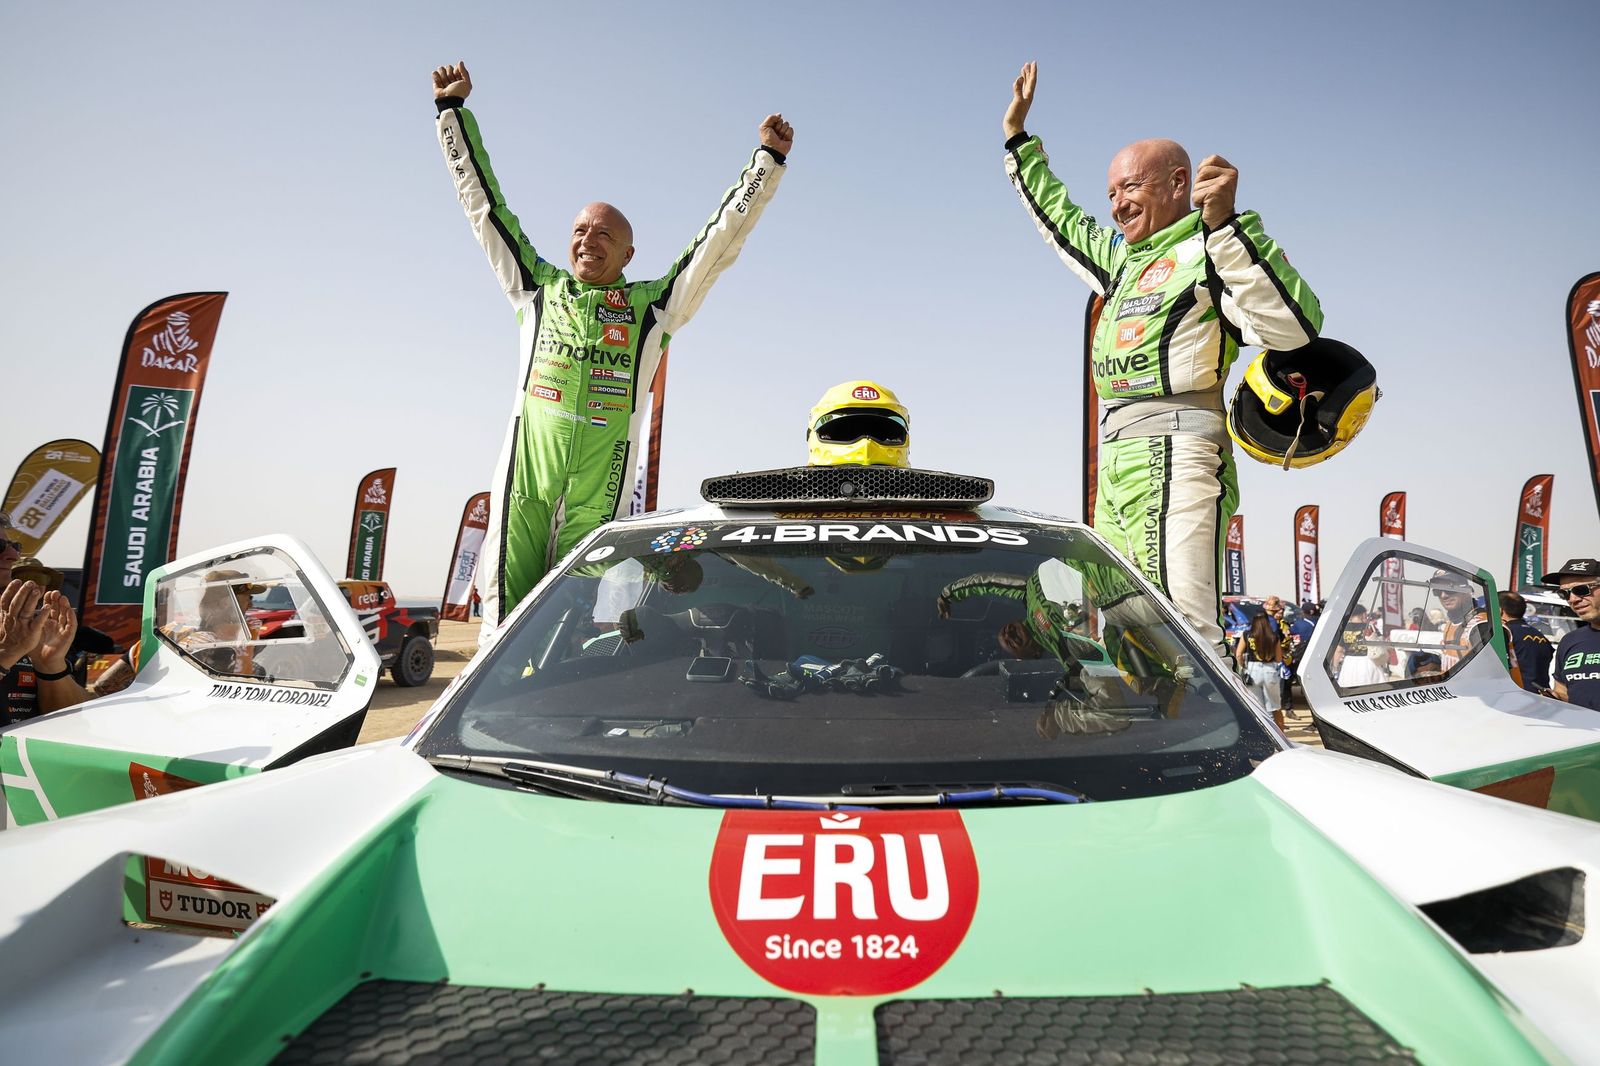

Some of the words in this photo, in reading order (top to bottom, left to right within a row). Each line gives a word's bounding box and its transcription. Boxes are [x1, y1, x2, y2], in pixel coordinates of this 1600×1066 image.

[735, 167, 766, 214] Emotive
[609, 329, 625, 341] JBL
[1120, 328, 1140, 341] JBL
[142, 347, 198, 373] DAKAR
[854, 390, 878, 398] ERU
[131, 447, 160, 522] ARABIA
[123, 526, 148, 588] SAUDI
[455, 550, 475, 582] berain
[1303, 554, 1313, 594] Hero
[207, 684, 233, 699] TIM
[229, 686, 242, 699] &
[241, 686, 273, 702] TOM
[269, 689, 333, 708] CORONEL
[1343, 698, 1377, 714] TIM
[1369, 697, 1387, 711] &
[1377, 692, 1411, 710] TOM
[1405, 685, 1458, 706] CORONEL
[736, 833, 949, 921] ERU
[177, 894, 252, 920] TUDOR
[764, 933, 842, 960] Since
[850, 934, 920, 960] 1824
